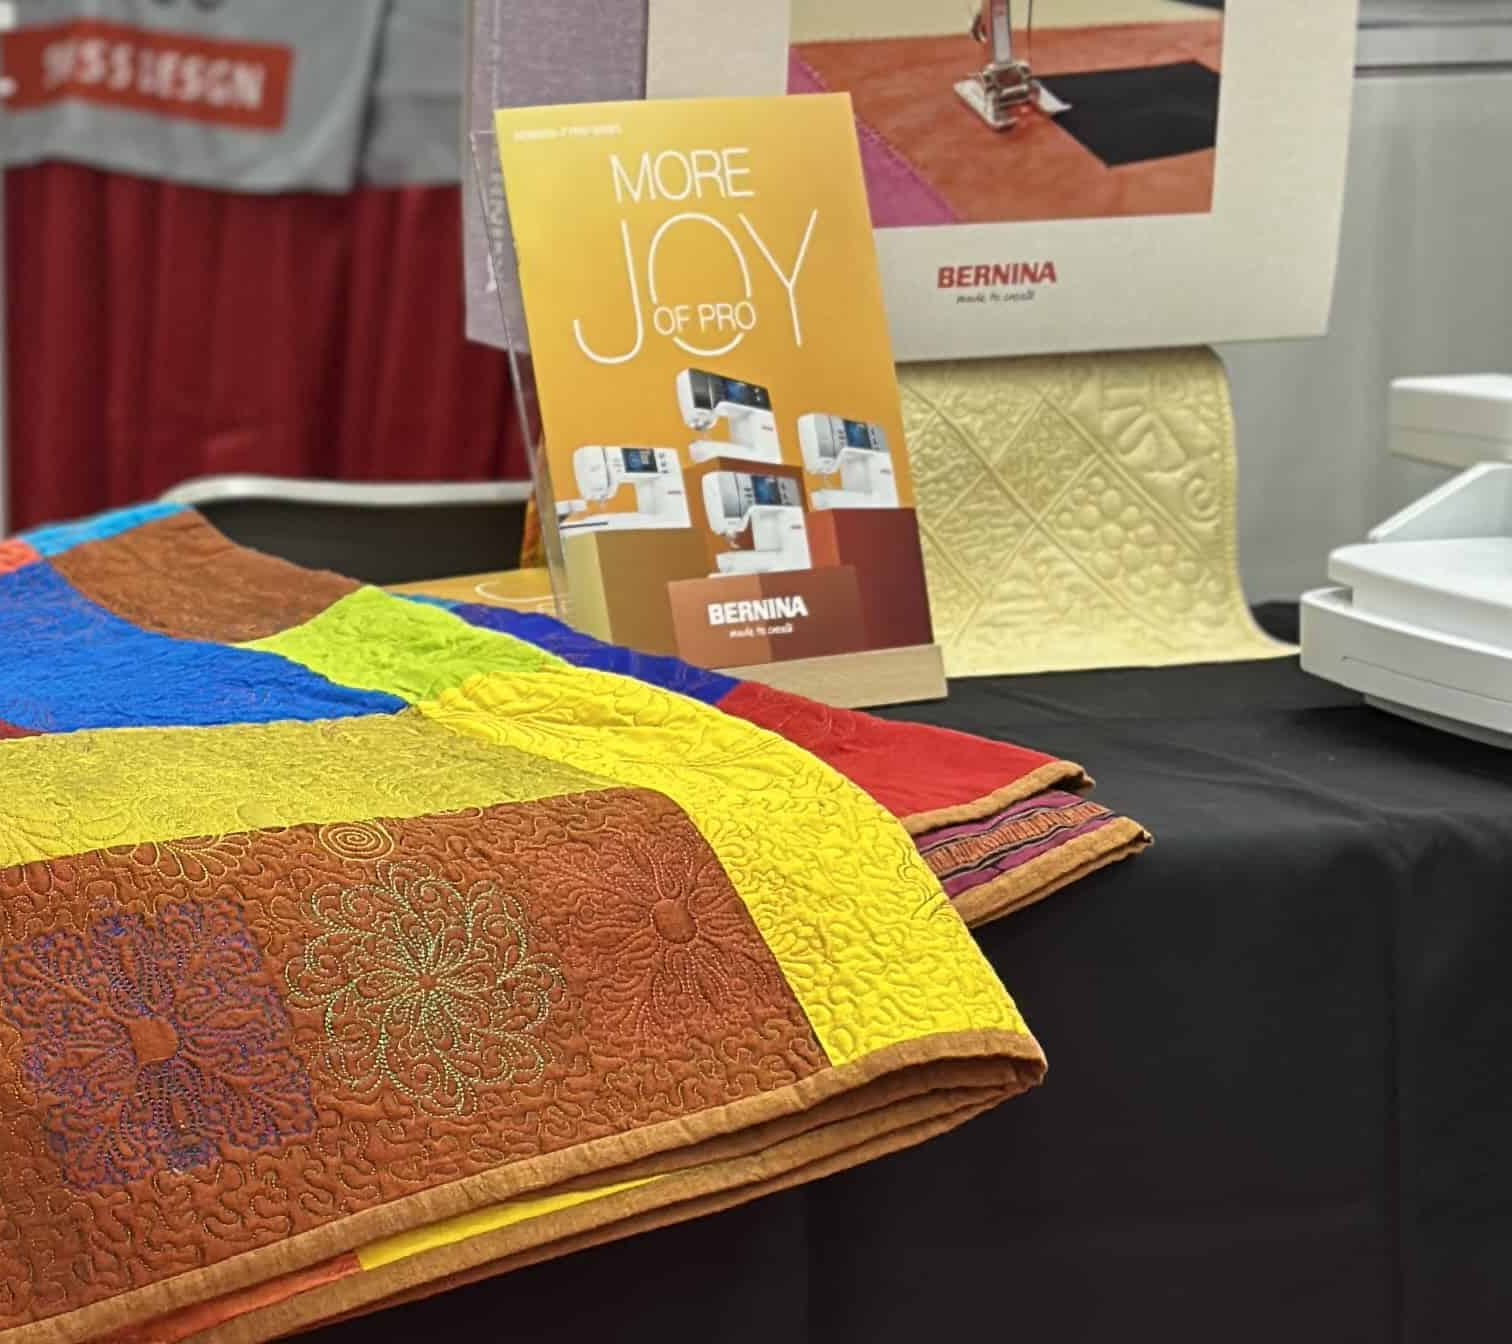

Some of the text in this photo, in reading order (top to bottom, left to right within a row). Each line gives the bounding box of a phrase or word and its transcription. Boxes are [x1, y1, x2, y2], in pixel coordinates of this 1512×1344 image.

[610, 147, 756, 204] MORE
[573, 208, 818, 364] JOY
[937, 261, 1057, 288] BERNINA
[653, 301, 757, 336] OF PRO
[708, 595, 809, 625] BERNINA
